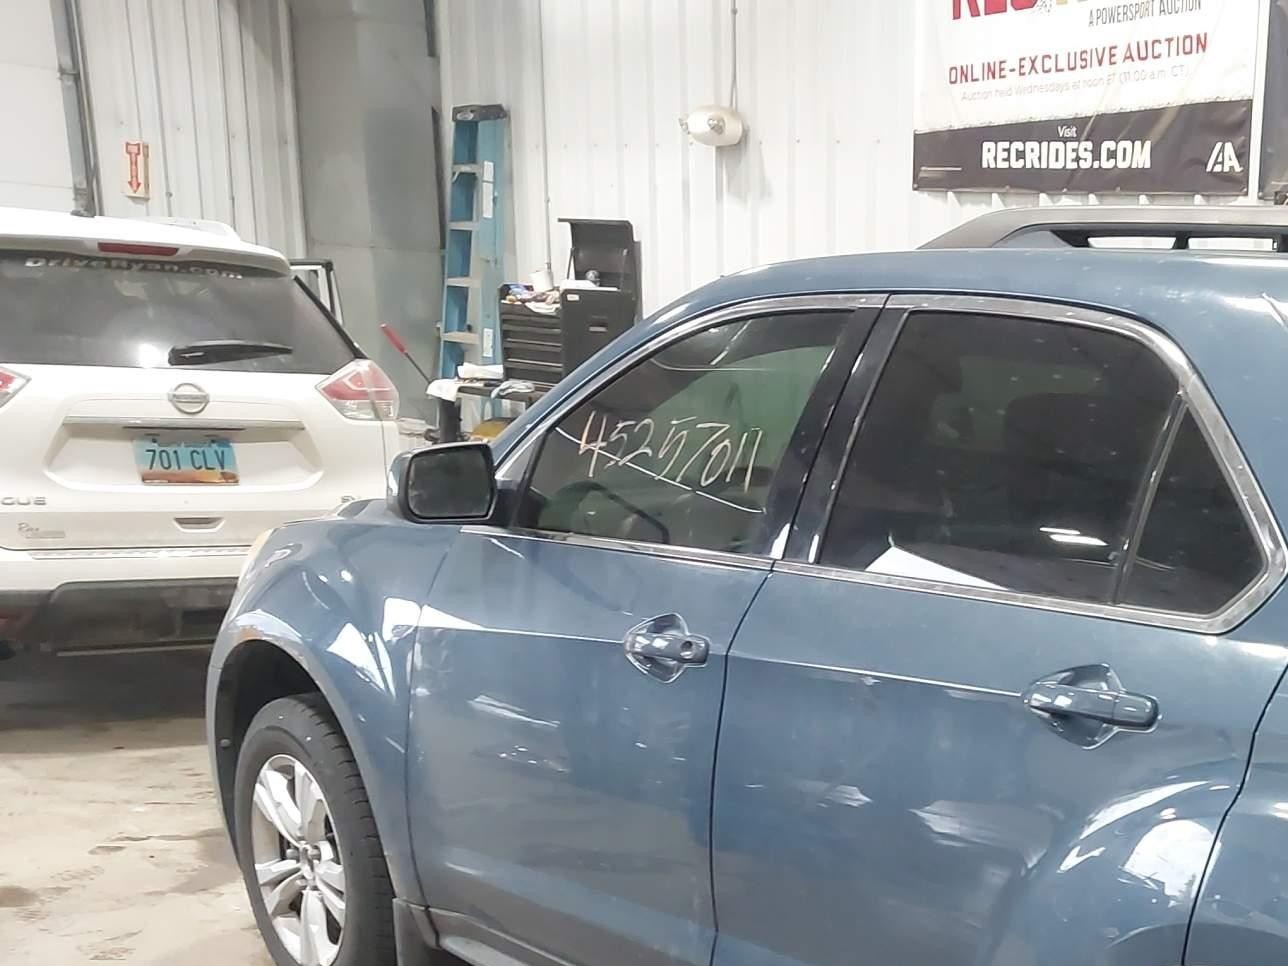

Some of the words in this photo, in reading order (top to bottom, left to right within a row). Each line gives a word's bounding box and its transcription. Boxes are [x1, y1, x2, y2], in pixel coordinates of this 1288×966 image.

[1088, 9, 1095, 27] A
[1096, 0, 1155, 26] POWERSPORT
[1160, 0, 1202, 16] AUCTION
[949, 45, 1118, 85] ONLINE-EXCLUSIVE
[1122, 32, 1208, 63] AUCTION
[1058, 125, 1077, 137] Visit
[981, 140, 1152, 169] RECRIDES.COM
[145, 449, 182, 472] 701
[190, 449, 225, 472] CLV
[578, 410, 764, 494] 45257011
